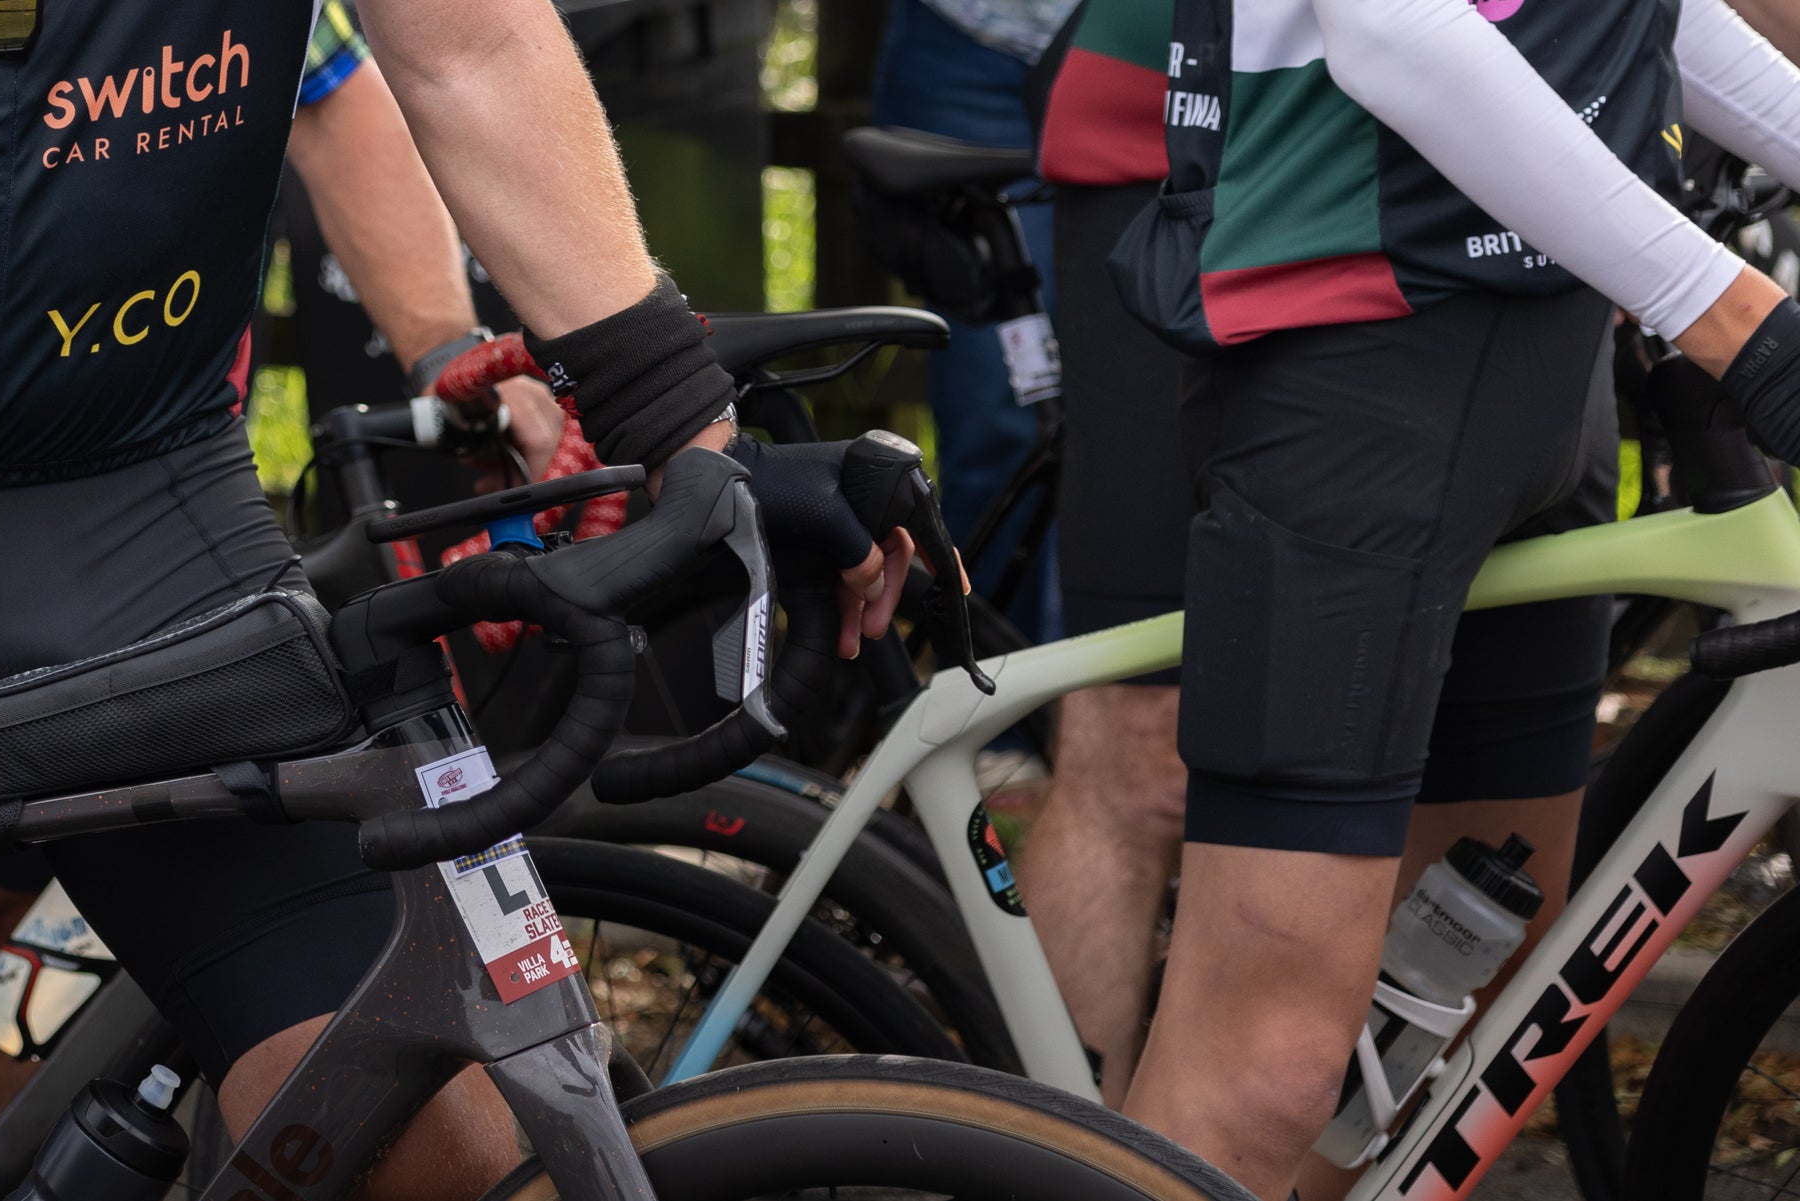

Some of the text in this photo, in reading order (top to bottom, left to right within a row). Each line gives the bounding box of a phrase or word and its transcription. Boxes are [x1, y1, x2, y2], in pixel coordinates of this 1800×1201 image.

[43, 29, 250, 130] switch
[42, 105, 245, 170] CAR RENTAL
[523, 901, 551, 922] RACE
[1408, 896, 1476, 957] CLASSIC
[1416, 889, 1481, 943] dartmoor
[517, 953, 546, 973] VILLA
[524, 964, 550, 984] PARK
[1398, 768, 1750, 1194] TREK
